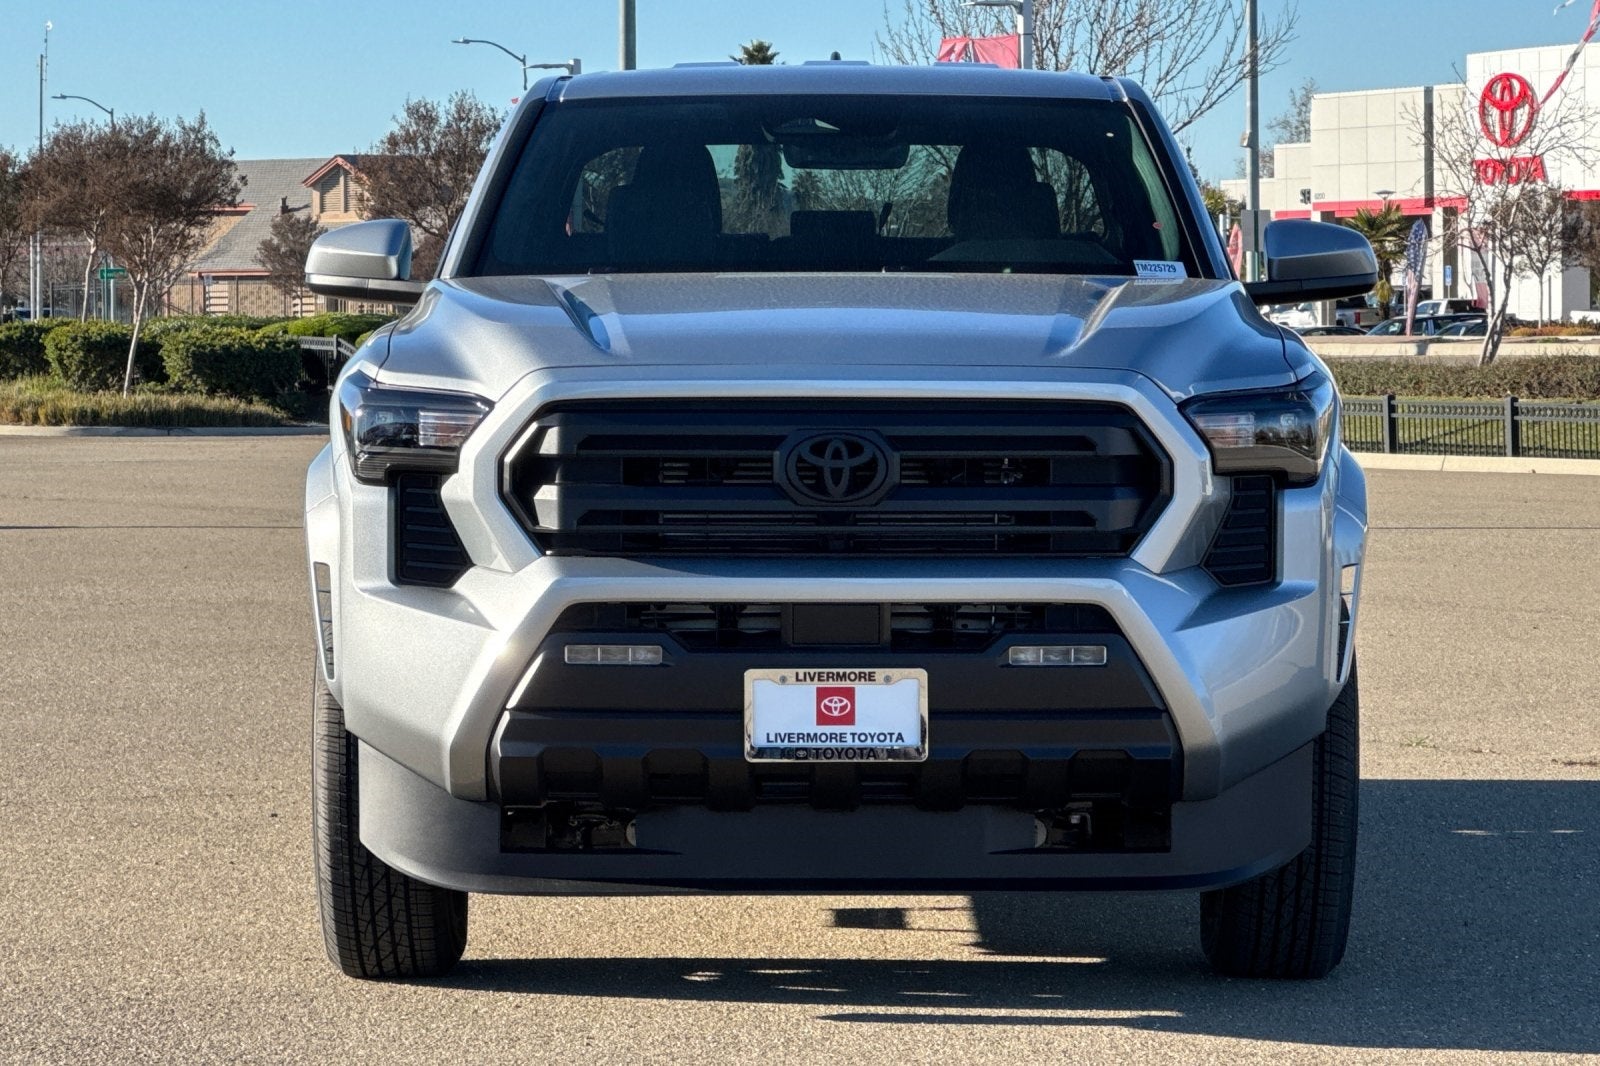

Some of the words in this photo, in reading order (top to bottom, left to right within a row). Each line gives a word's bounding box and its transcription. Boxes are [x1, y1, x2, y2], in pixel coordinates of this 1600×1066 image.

[1472, 156, 1546, 186] TOYOTA
[1136, 263, 1177, 273] TM225729
[795, 671, 876, 683] LIVERMORE
[766, 732, 847, 744] LIVERMORE
[850, 732, 905, 744] TOYOTA
[813, 747, 878, 760] TOYOTA
